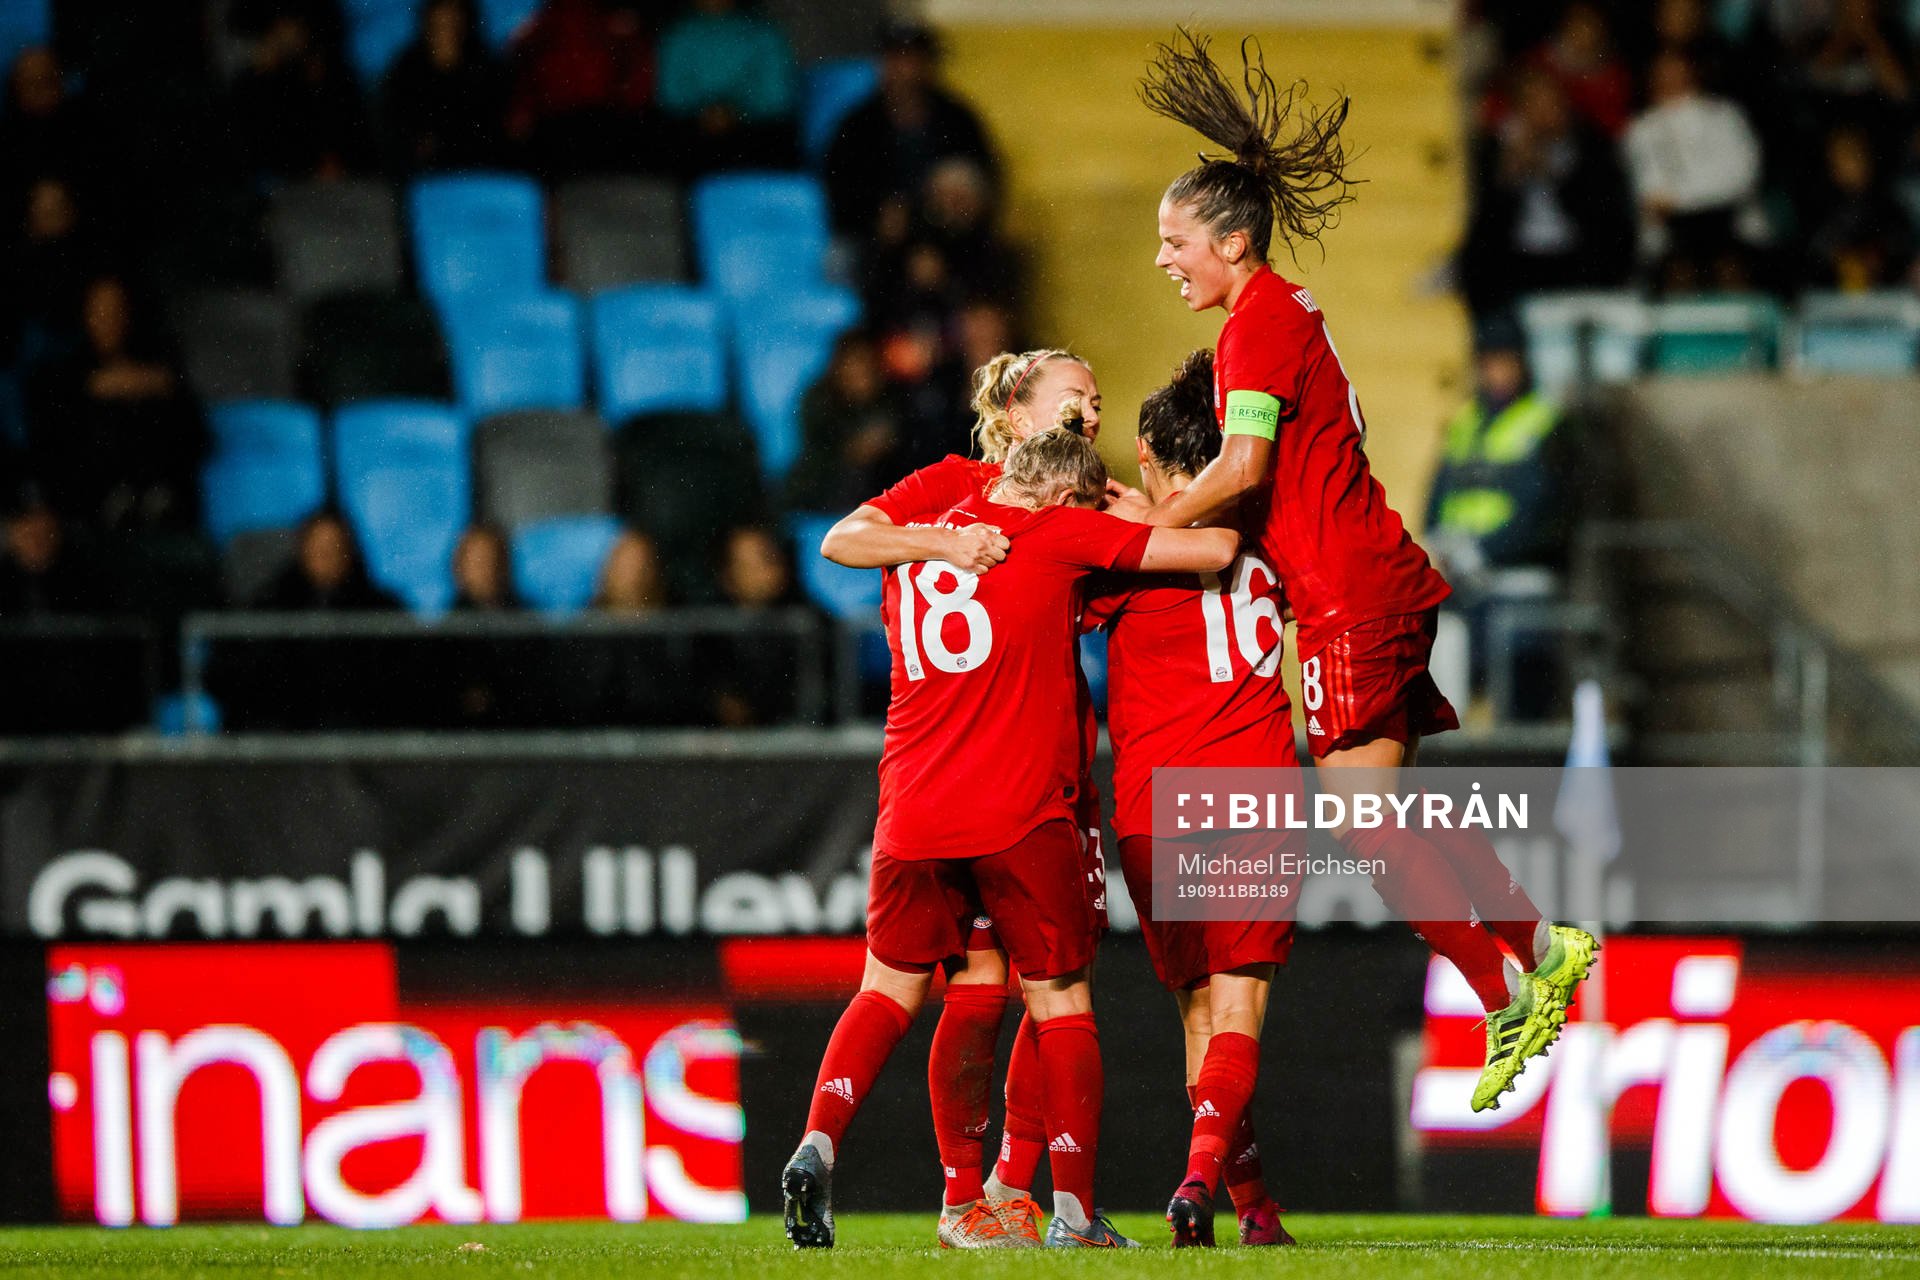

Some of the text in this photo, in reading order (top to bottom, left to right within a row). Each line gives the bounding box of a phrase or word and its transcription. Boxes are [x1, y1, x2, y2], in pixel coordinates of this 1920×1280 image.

[1238, 408, 1276, 423] RESPECT
[897, 560, 993, 682] 18
[1200, 555, 1284, 683] 16
[1303, 656, 1323, 711] 8
[820, 1085, 855, 1104] adidas
[1048, 1144, 1082, 1153] adidas
